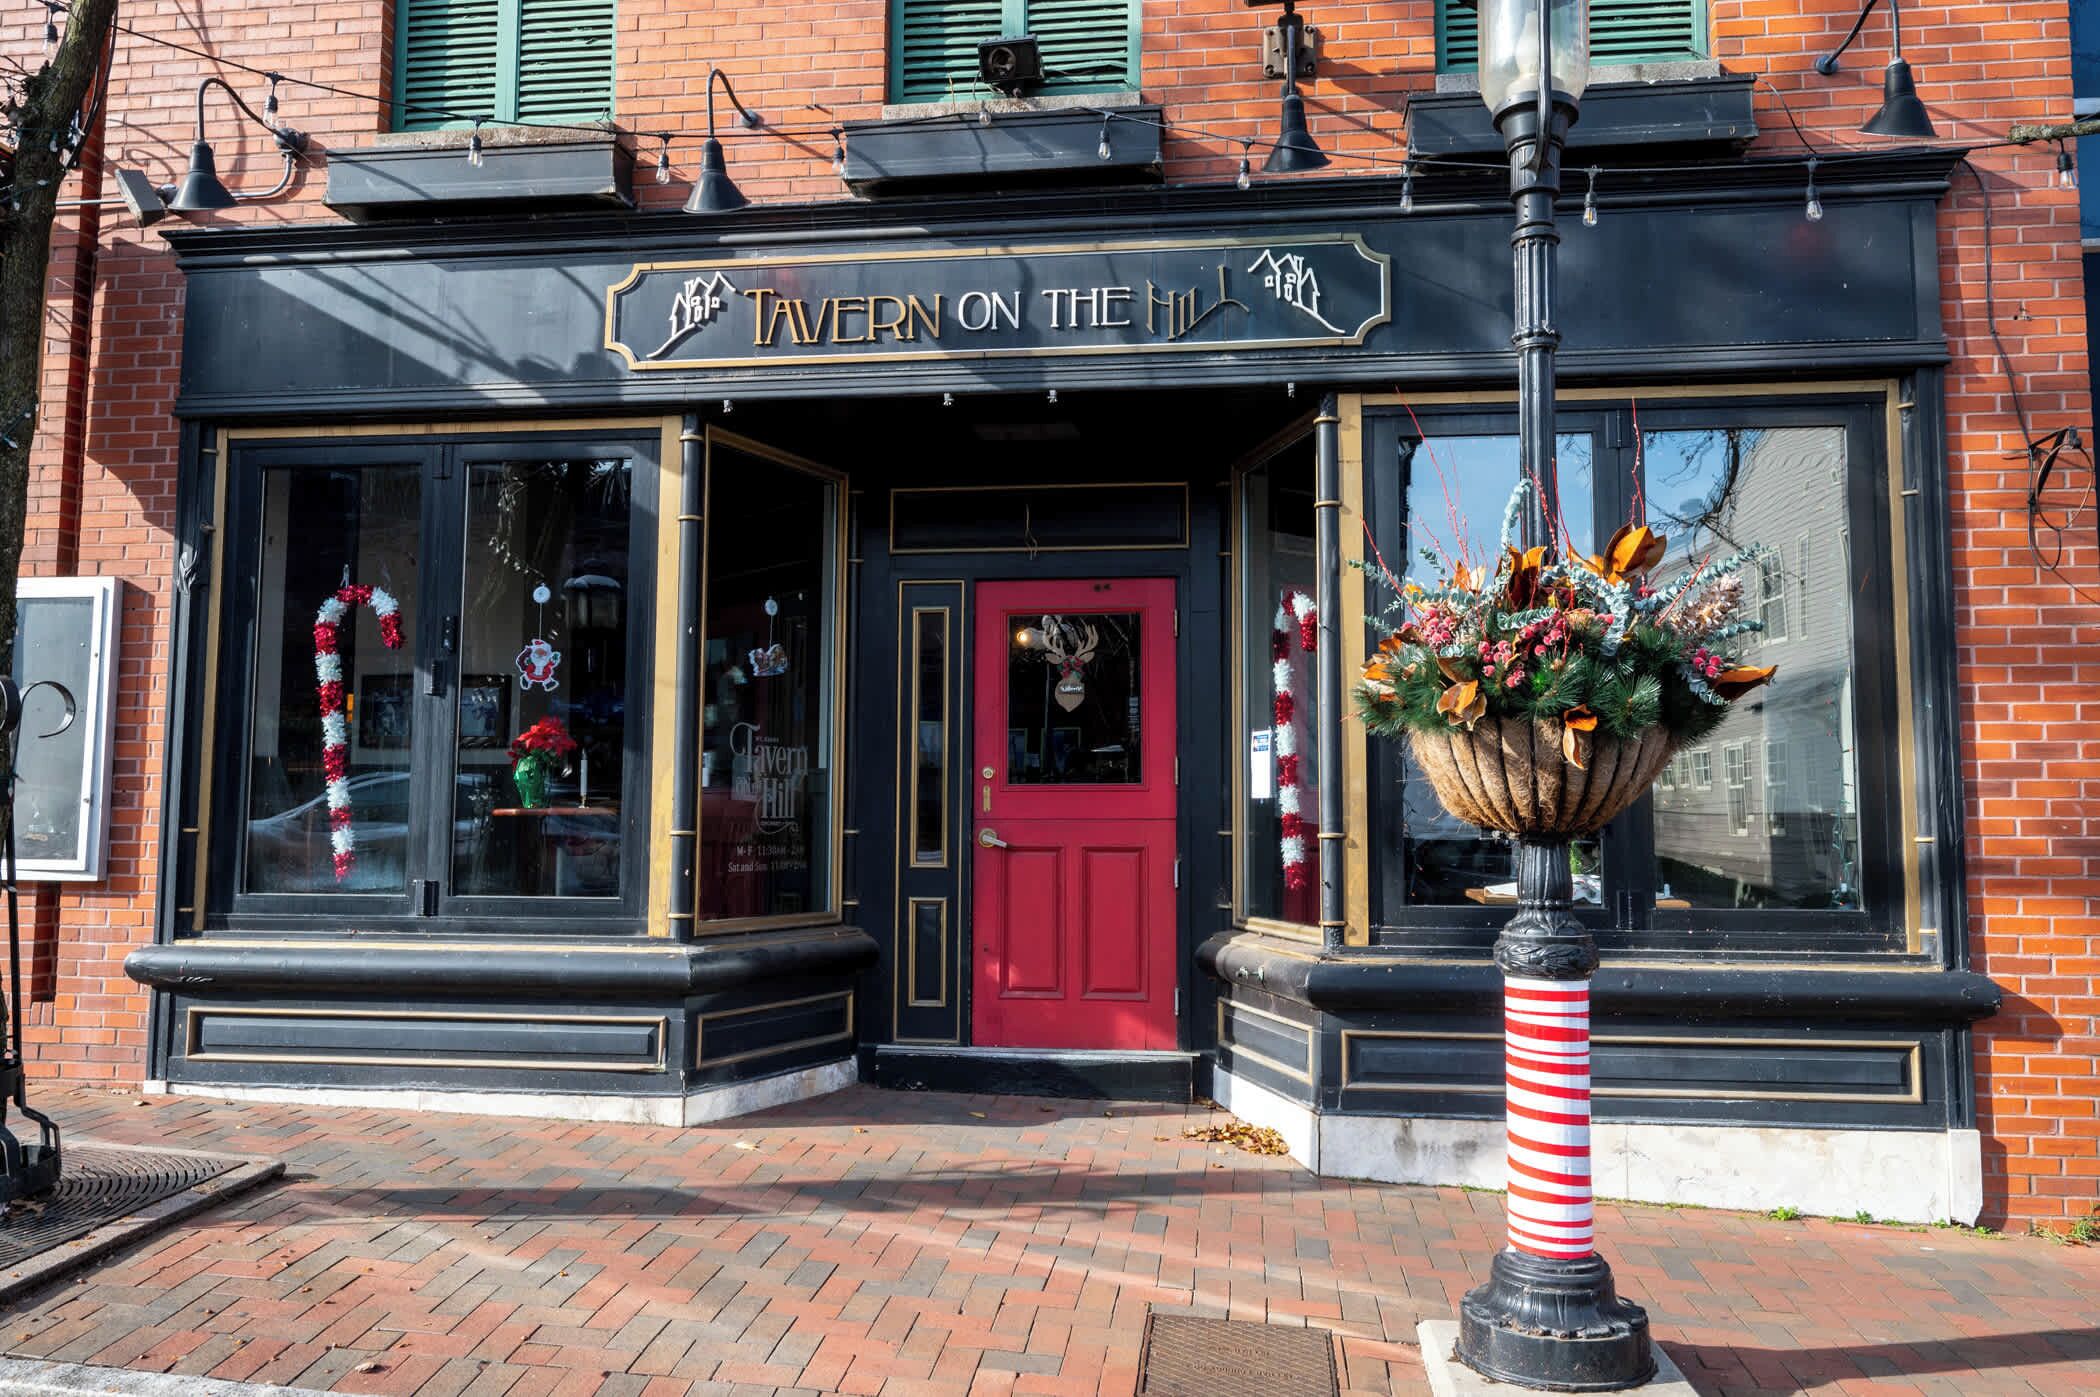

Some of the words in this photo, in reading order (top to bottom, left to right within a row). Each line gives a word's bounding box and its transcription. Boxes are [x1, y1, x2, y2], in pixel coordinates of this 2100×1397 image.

[743, 288, 944, 345] TAVERN
[958, 290, 1021, 331] ON
[1041, 286, 1132, 329] THE
[1146, 264, 1249, 340] HILL
[729, 721, 809, 777] Tavern
[759, 776, 799, 820] Hill
